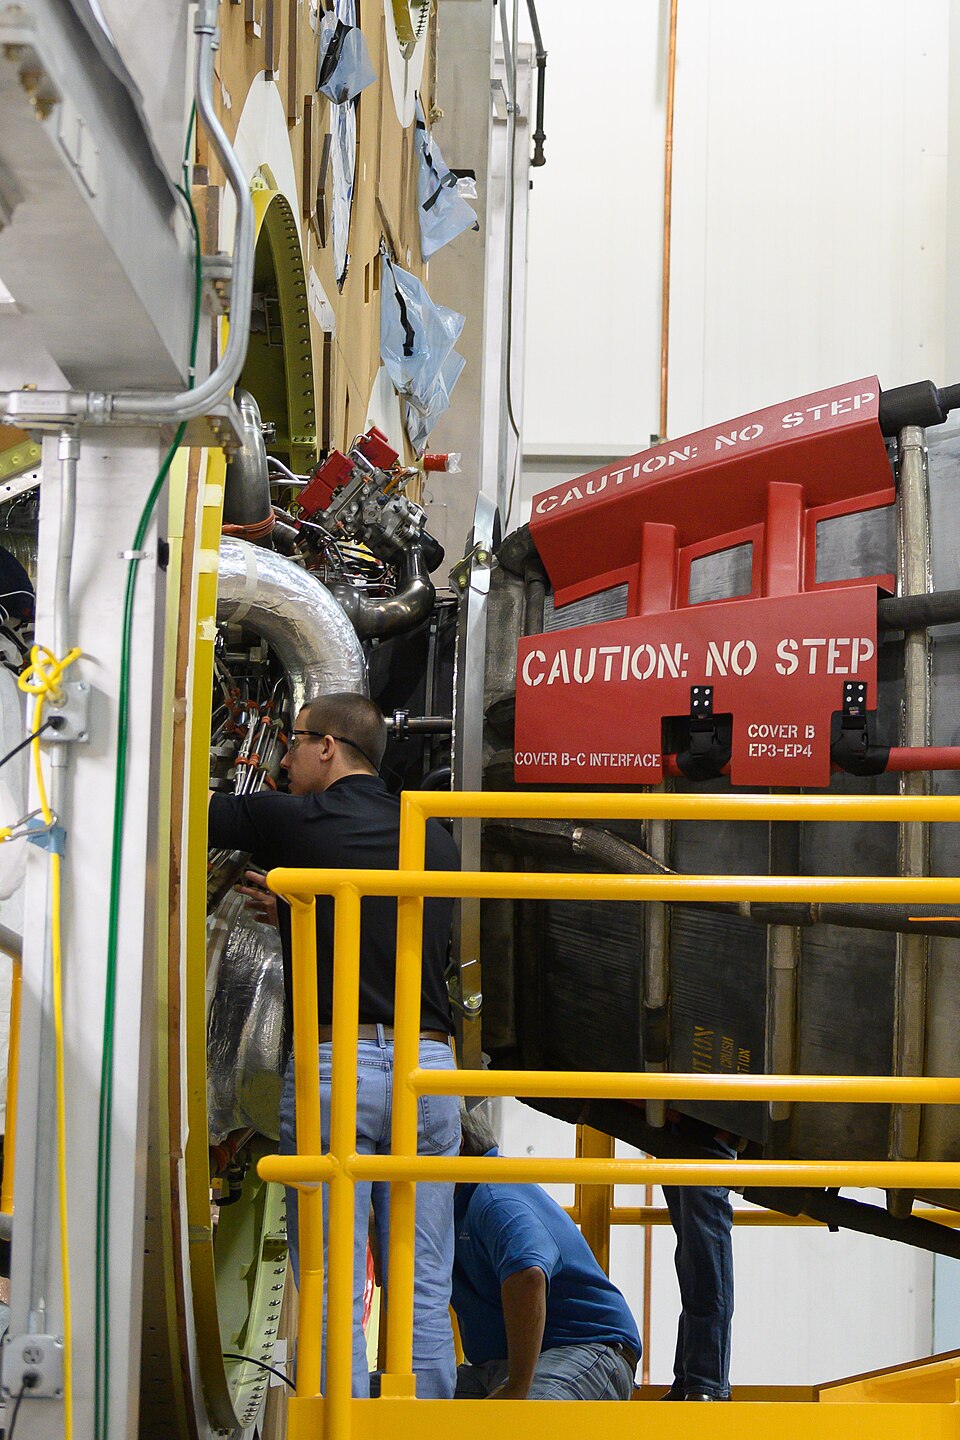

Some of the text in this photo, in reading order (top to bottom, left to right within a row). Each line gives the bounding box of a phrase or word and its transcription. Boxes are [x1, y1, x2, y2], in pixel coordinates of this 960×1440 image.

[535, 391, 876, 515] CAUTION: NO STEP
[522, 637, 875, 686] CAUTION: NO STEP
[747, 724, 815, 739] COVER B
[748, 743, 812, 759] EP3-EP4
[514, 752, 660, 768] COVER B-C INTERFACE
